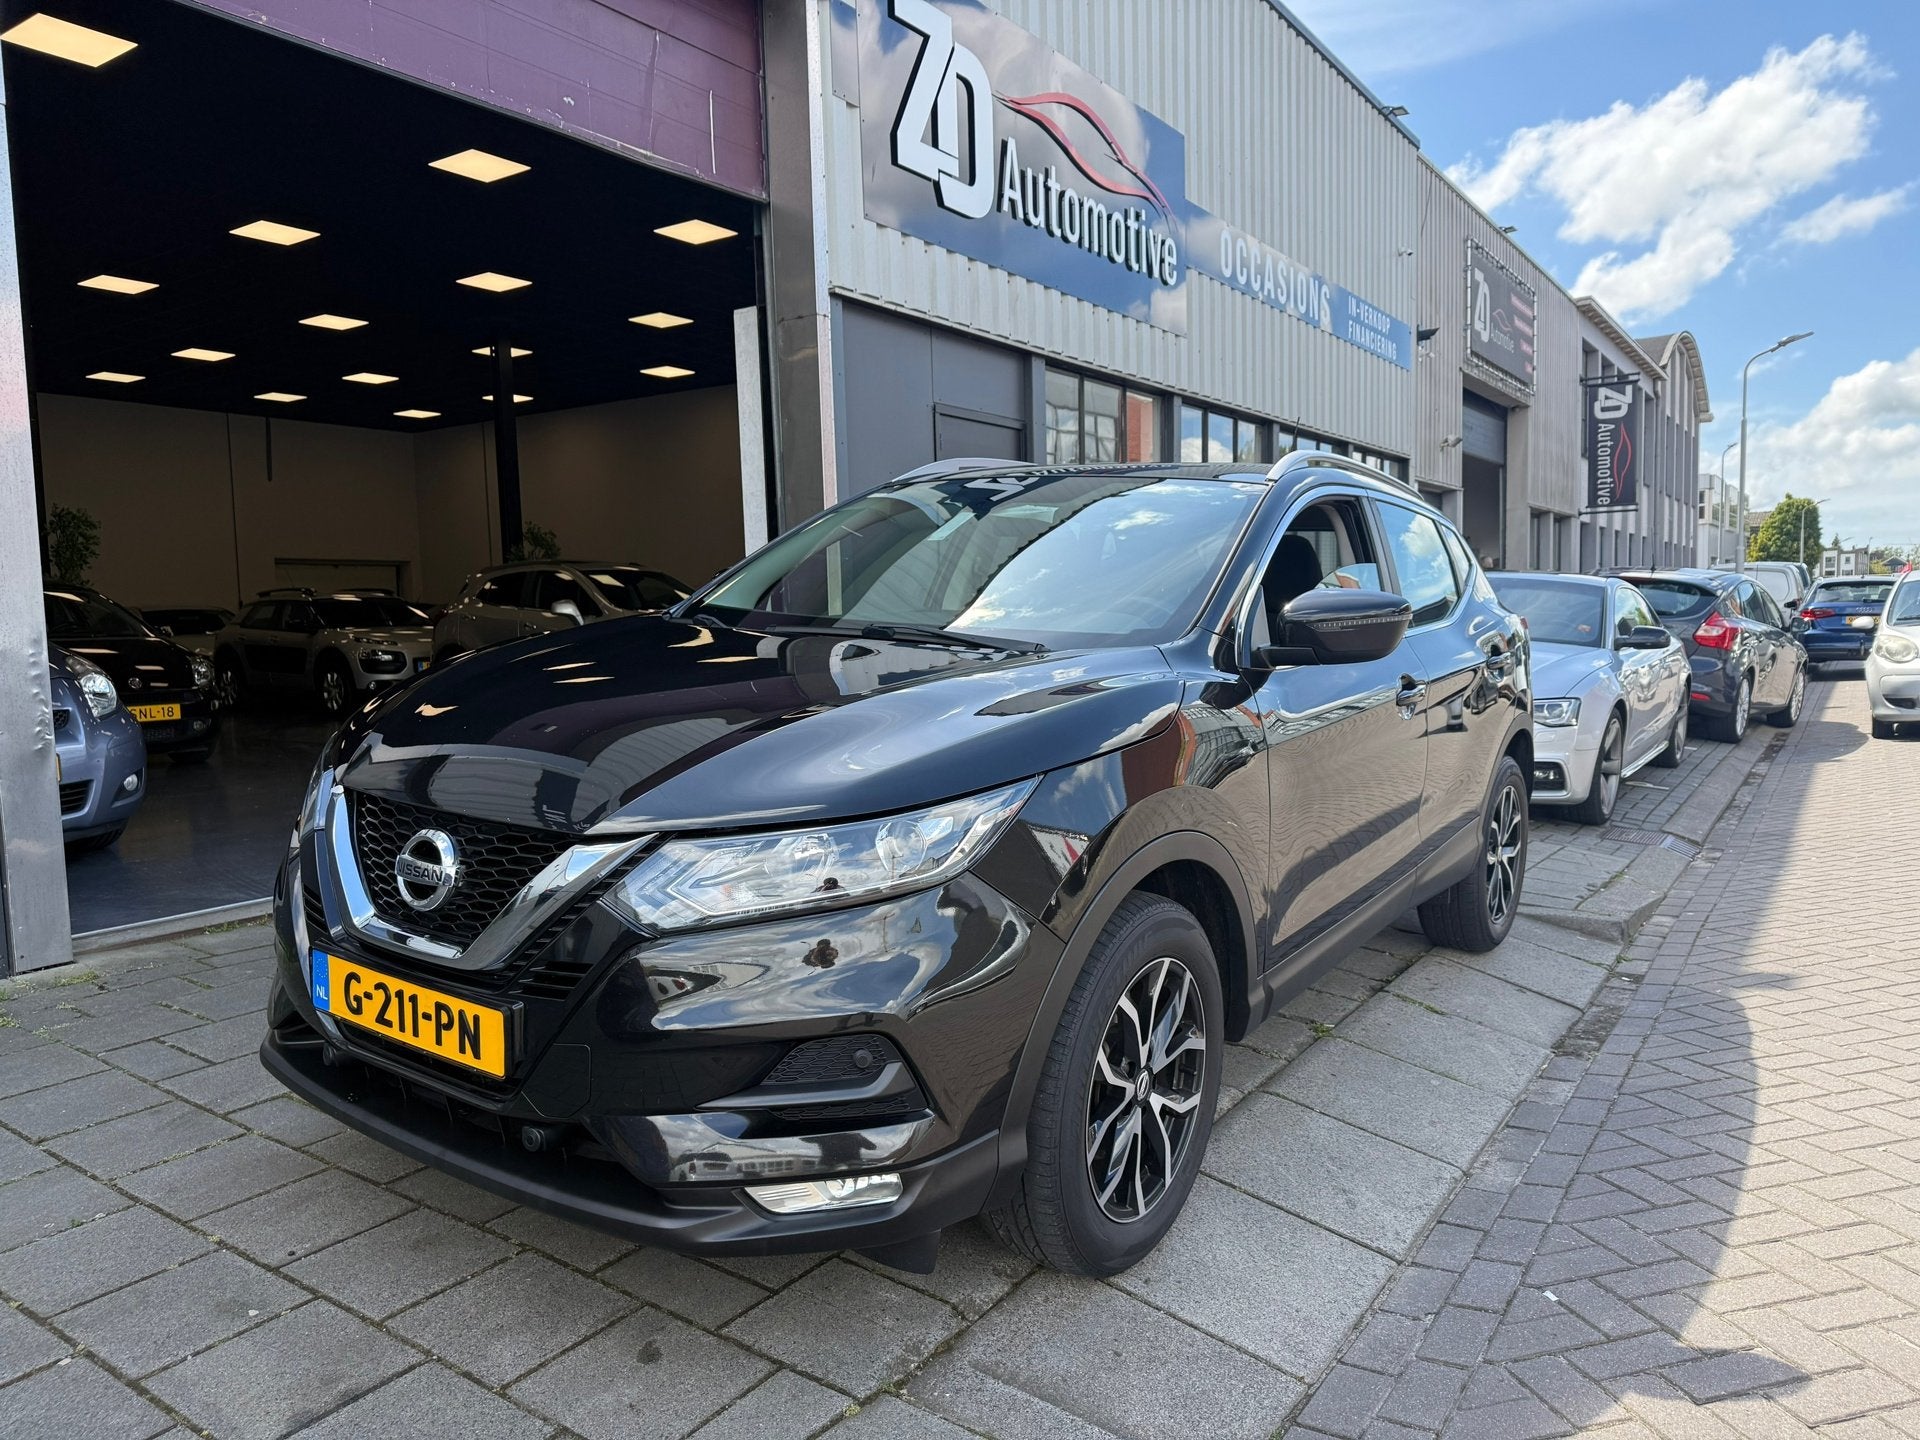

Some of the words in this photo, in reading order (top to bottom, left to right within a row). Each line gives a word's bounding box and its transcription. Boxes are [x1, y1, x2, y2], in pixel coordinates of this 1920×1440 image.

[888, 0, 994, 219] ZD
[998, 136, 1177, 286] Automotive
[1220, 229, 1330, 323] OCCASIONS
[1348, 295, 1391, 335] IN-VERKOOP
[1348, 319, 1397, 361] FINANCIERING
[1594, 385, 1633, 420] ZD
[1597, 423, 1616, 505] Automotive
[399, 860, 443, 883] NISSAN
[316, 984, 329, 1000] NL
[344, 971, 482, 1060] G-211-PN
